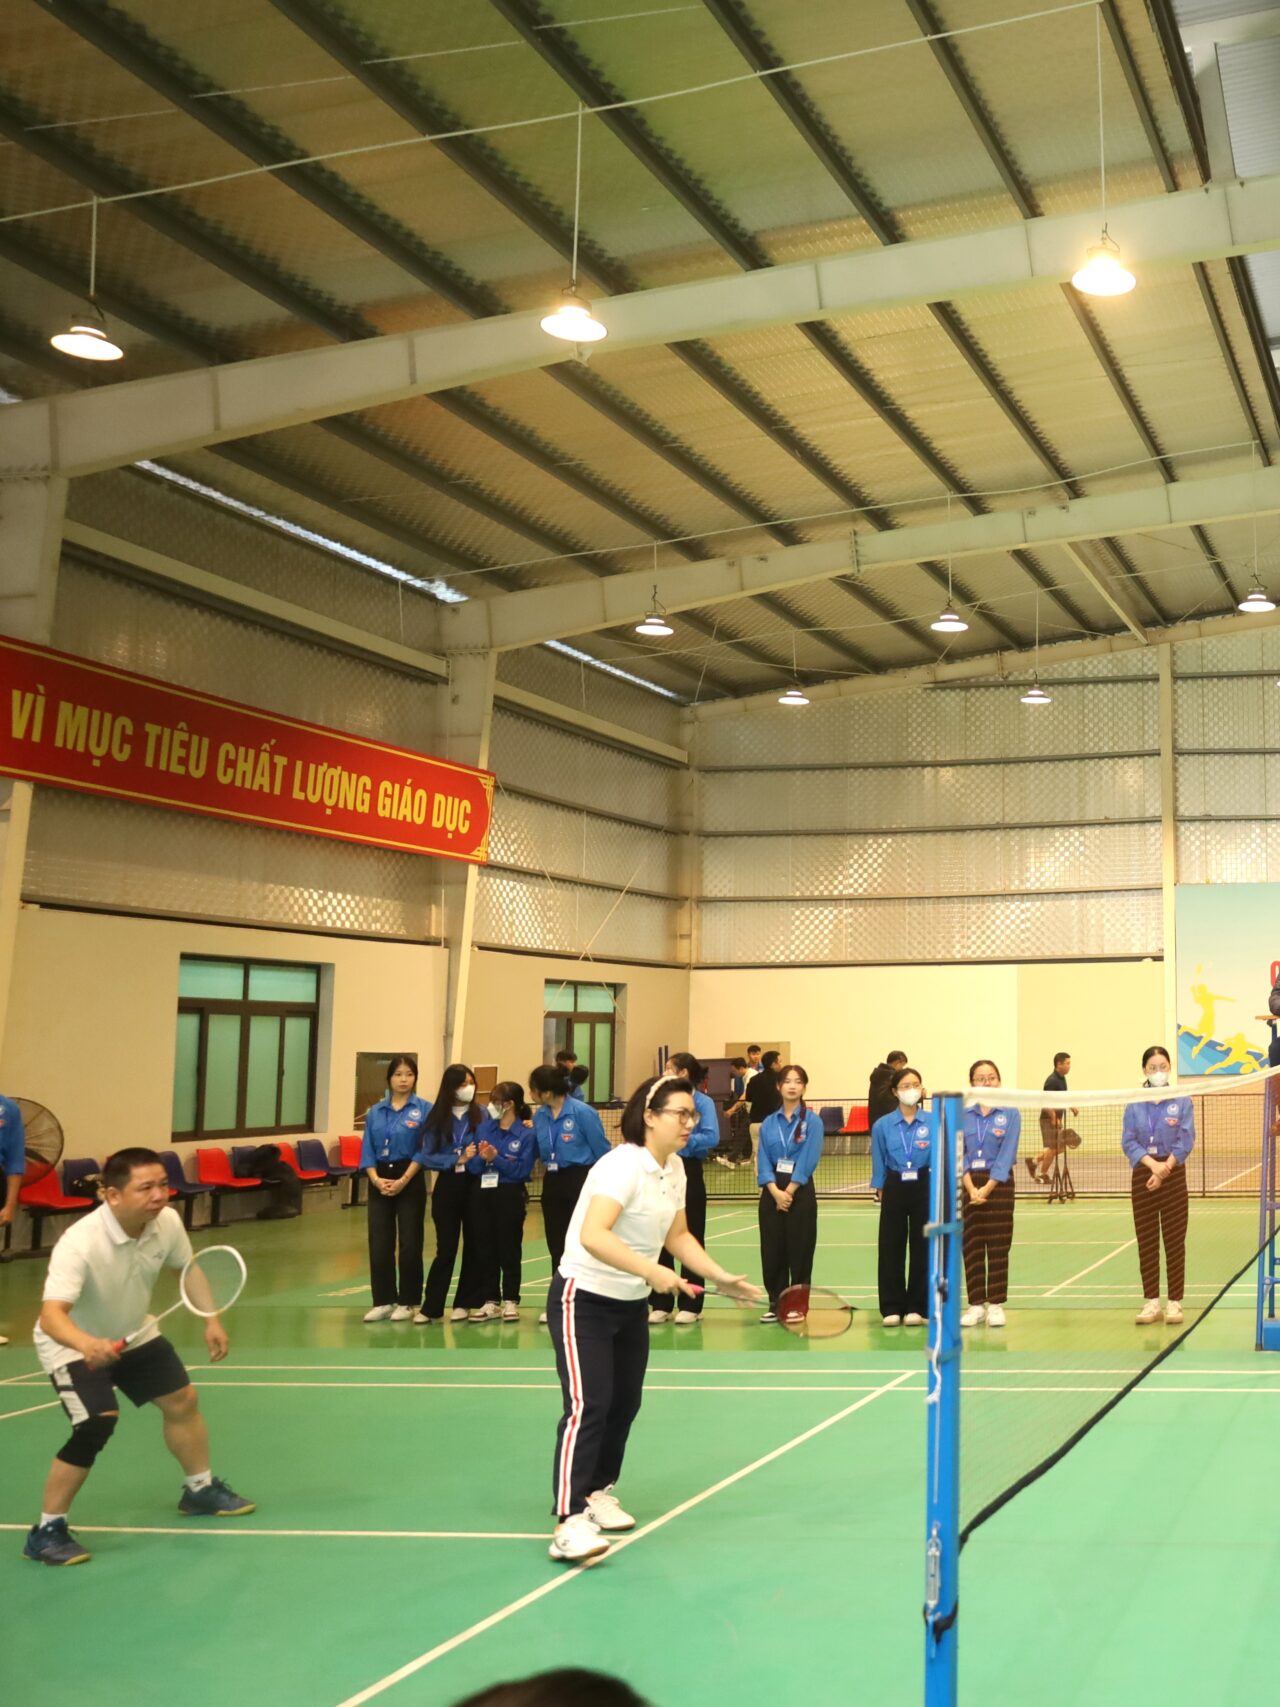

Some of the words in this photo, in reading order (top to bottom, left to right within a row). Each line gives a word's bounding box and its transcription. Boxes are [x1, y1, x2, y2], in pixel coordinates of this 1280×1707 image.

[11, 683, 46, 743] VÌ
[54, 700, 134, 767] MỤC
[144, 721, 210, 779] TIÊU
[216, 738, 288, 796] CHẤT
[292, 760, 372, 815] LƯỢNG
[377, 778, 428, 826] GIÁO
[431, 792, 472, 839] DỤC
